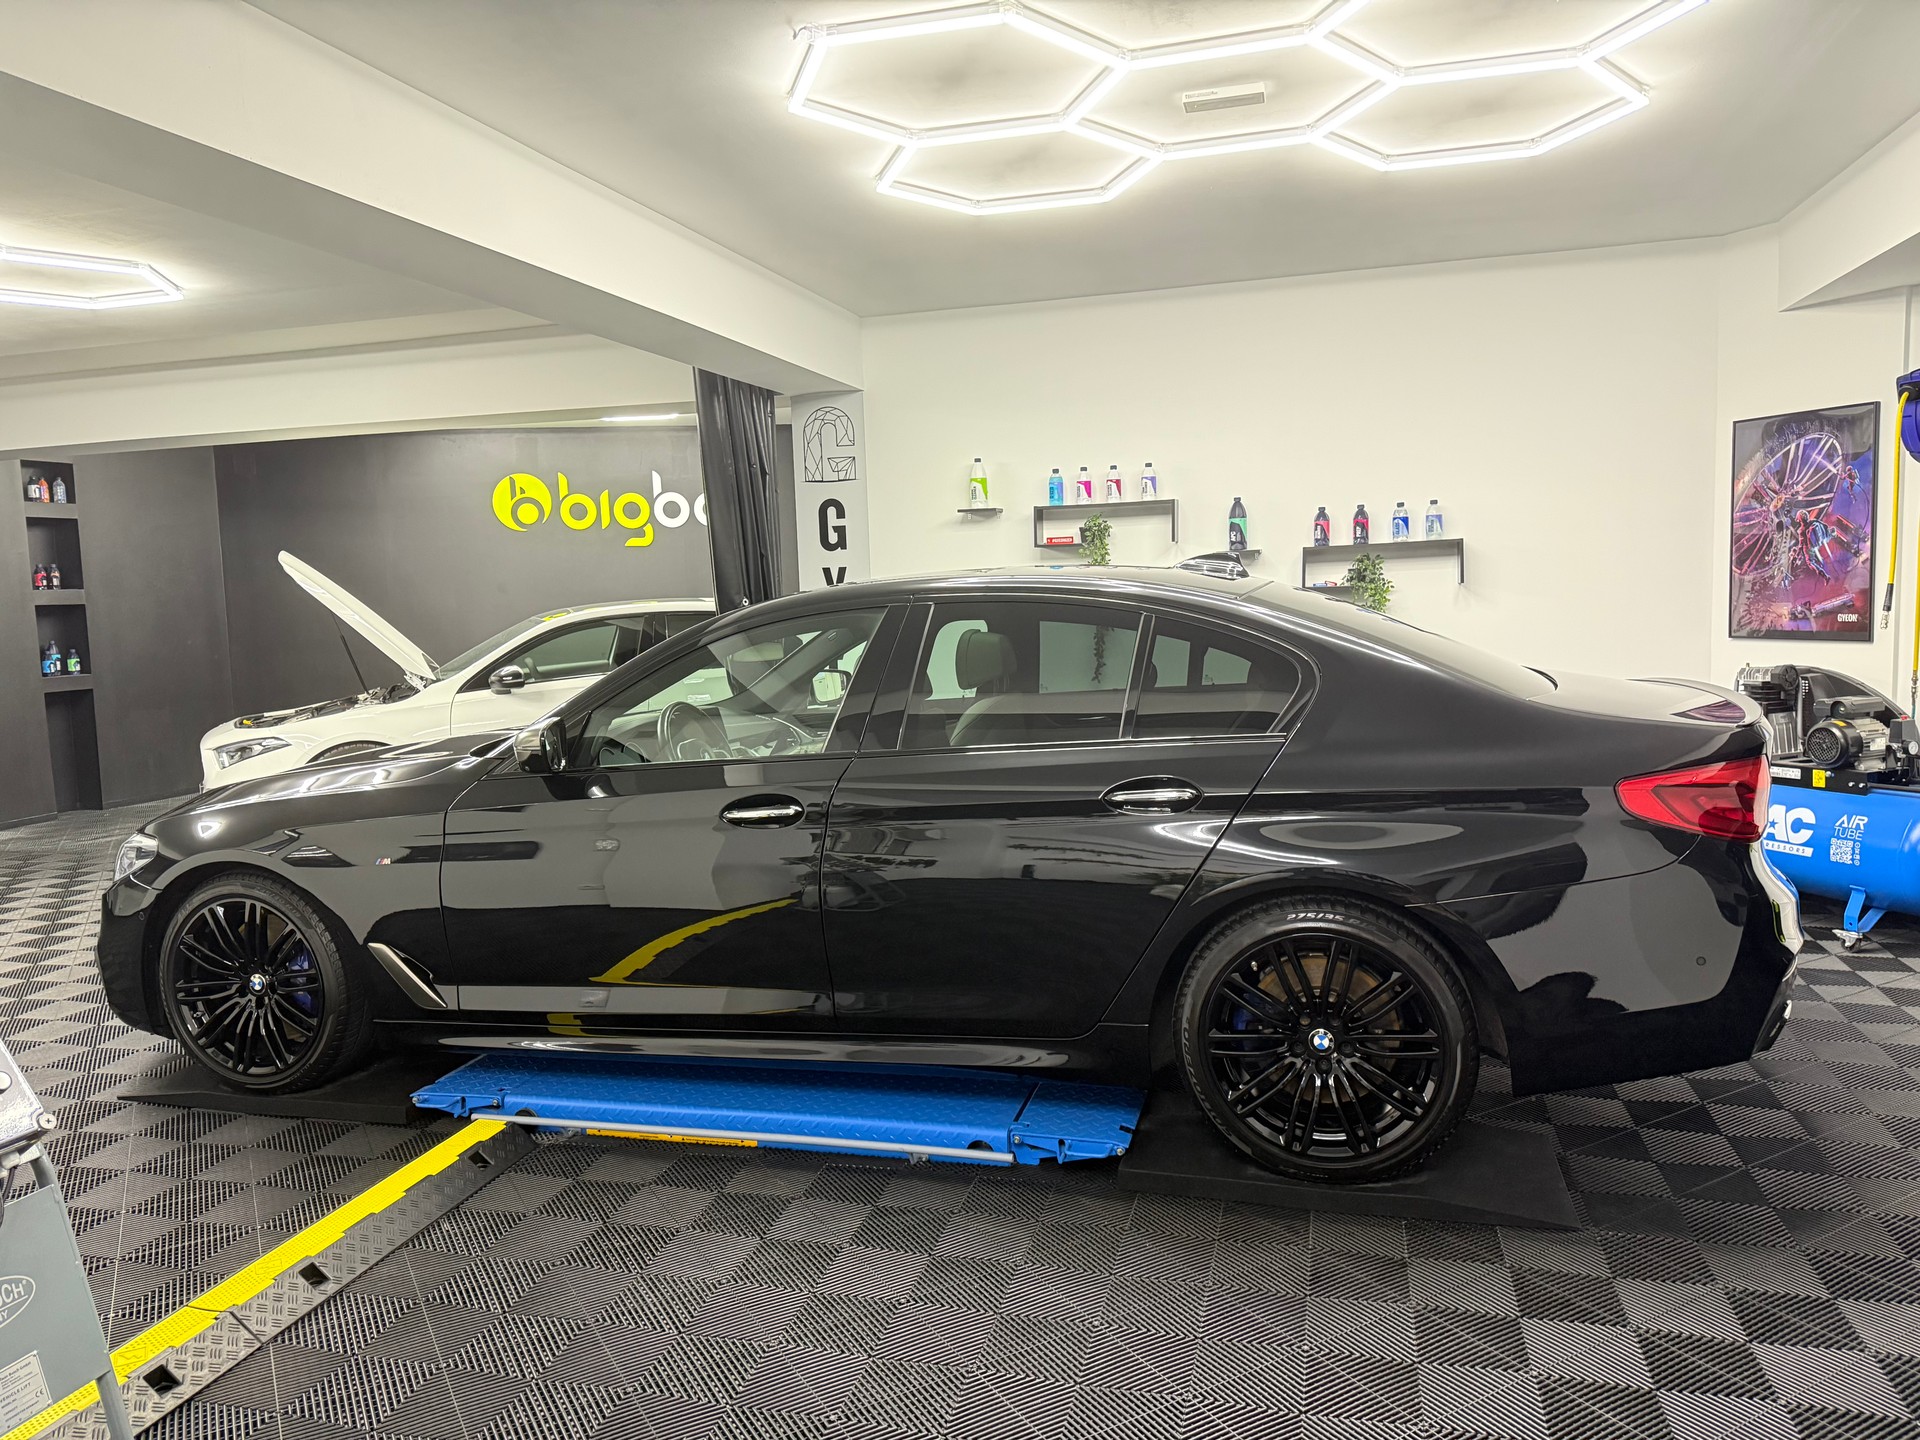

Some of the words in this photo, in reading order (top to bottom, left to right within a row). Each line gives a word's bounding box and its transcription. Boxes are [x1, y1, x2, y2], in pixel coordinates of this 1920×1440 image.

[1837, 613, 1858, 622] GYEON
[1834, 814, 1869, 830] AIR
[1833, 826, 1864, 840] TUBE
[21, 1382, 31, 1391] LIFT
